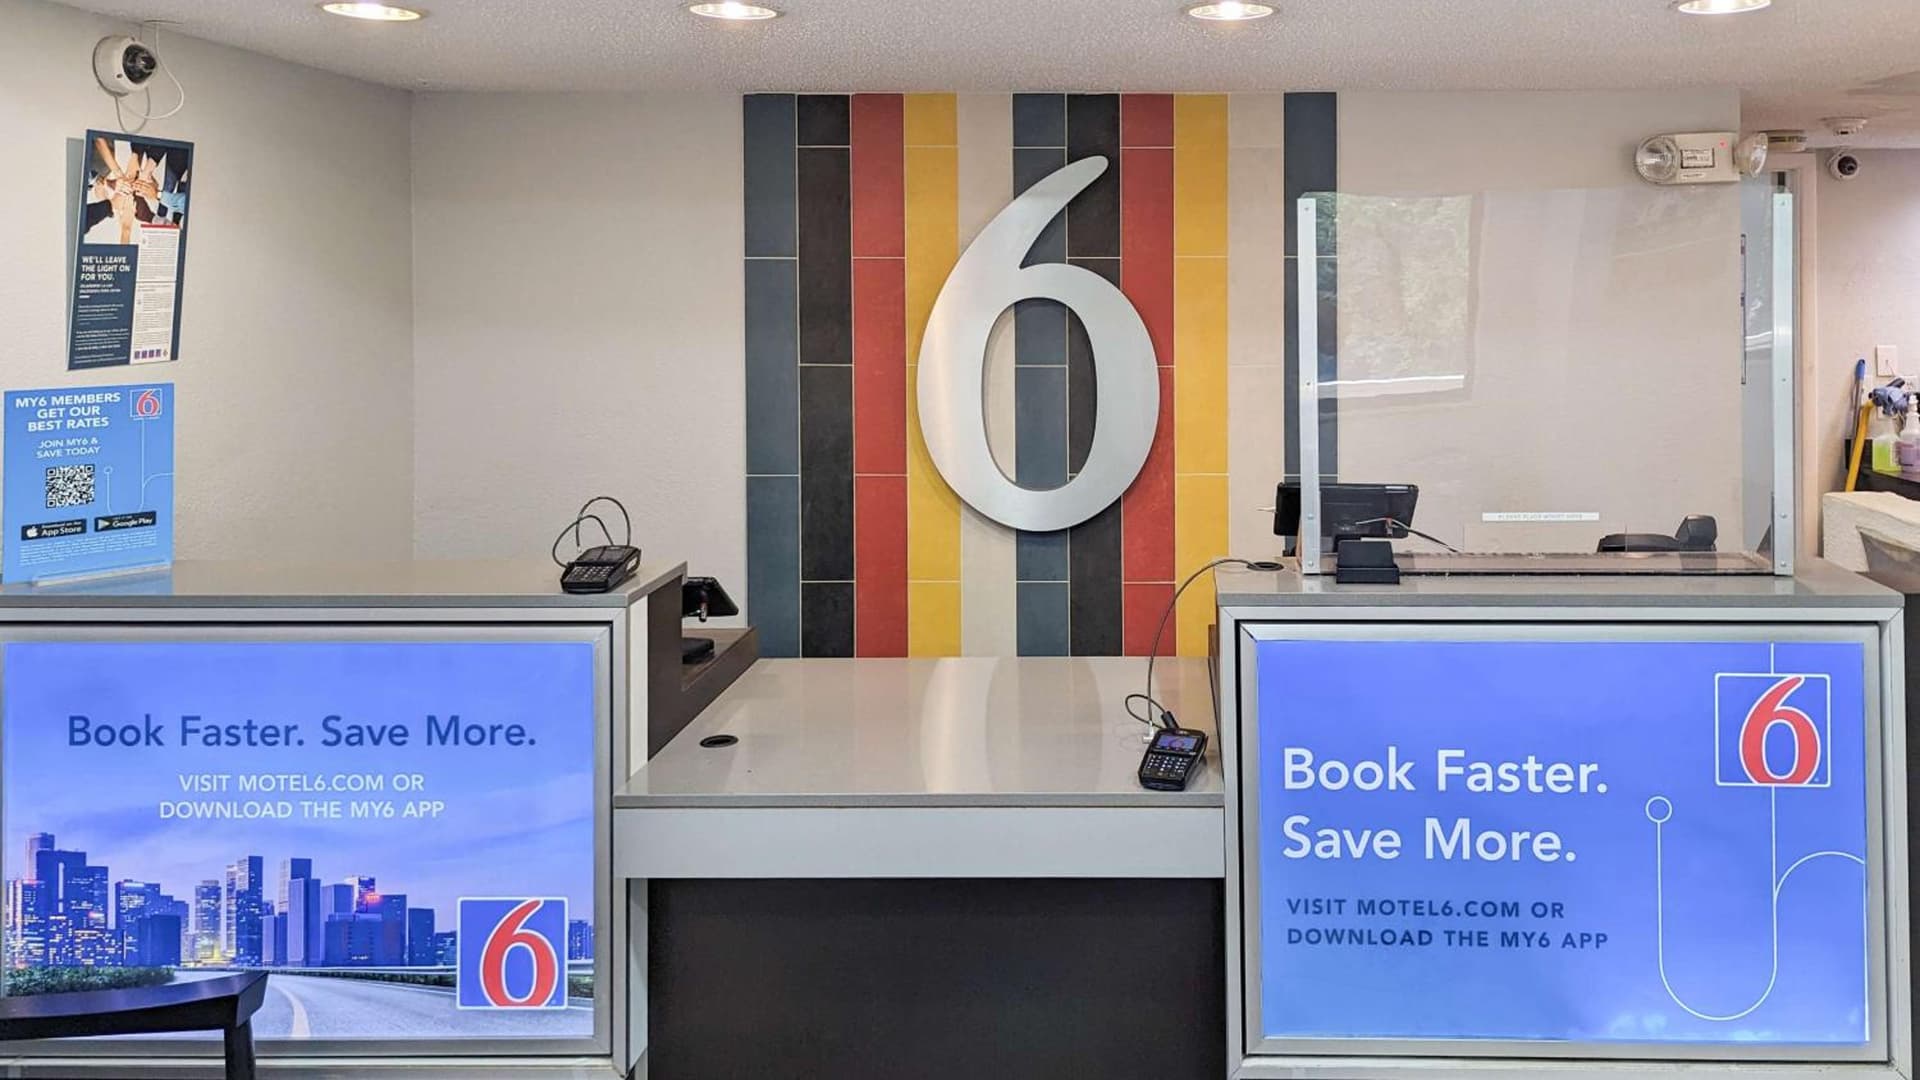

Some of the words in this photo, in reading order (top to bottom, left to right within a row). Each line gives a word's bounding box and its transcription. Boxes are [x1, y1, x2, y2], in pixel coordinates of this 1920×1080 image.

[81, 264, 96, 272] THE
[96, 264, 118, 272] LIGHT
[119, 264, 130, 272] ON
[82, 256, 103, 264] WE'LL
[105, 255, 127, 263] LEAVE
[80, 273, 96, 281] FOR
[97, 273, 115, 281] YOU.
[917, 155, 1160, 532] 6
[15, 398, 47, 408] MY6
[51, 392, 121, 406] MEMBERS
[136, 388, 160, 417] 6
[37, 407, 65, 419] GET
[69, 406, 101, 417] OUR
[28, 420, 63, 432] BEST
[66, 417, 109, 429] RATES
[38, 439, 63, 449] JOIN
[66, 438, 88, 447] MY6
[91, 437, 98, 445] &
[36, 450, 62, 459] SAVE
[66, 446, 101, 457] TODAY
[41, 527, 58, 537] App
[60, 525, 82, 535] Store
[112, 519, 137, 528] Google
[138, 516, 153, 526] Play
[68, 713, 165, 747] Book
[181, 715, 305, 747] Faster.
[321, 714, 410, 747] Save
[426, 714, 537, 747] More.
[1739, 674, 1821, 786] 6
[1283, 746, 1416, 791] Book
[1437, 748, 1608, 794] Faster.
[179, 774, 231, 792] VISIT
[239, 774, 384, 792] MOTEL6.COM
[392, 774, 425, 792] OR
[159, 801, 292, 819] DOWNLOAD
[301, 801, 342, 819] THE
[351, 801, 395, 819] MY6
[402, 801, 445, 819] APP
[1282, 814, 1402, 860] Save
[1424, 817, 1577, 863] More.
[1286, 898, 1347, 915] VISIT
[1357, 899, 1520, 918] MOTEL6.COM
[1531, 901, 1565, 919] OR
[1287, 928, 1434, 946] DOWNLOAD
[1444, 930, 1489, 948] THE
[1500, 931, 1551, 949] MY6
[1561, 933, 1609, 949] APP
[480, 897, 558, 1009] 6
